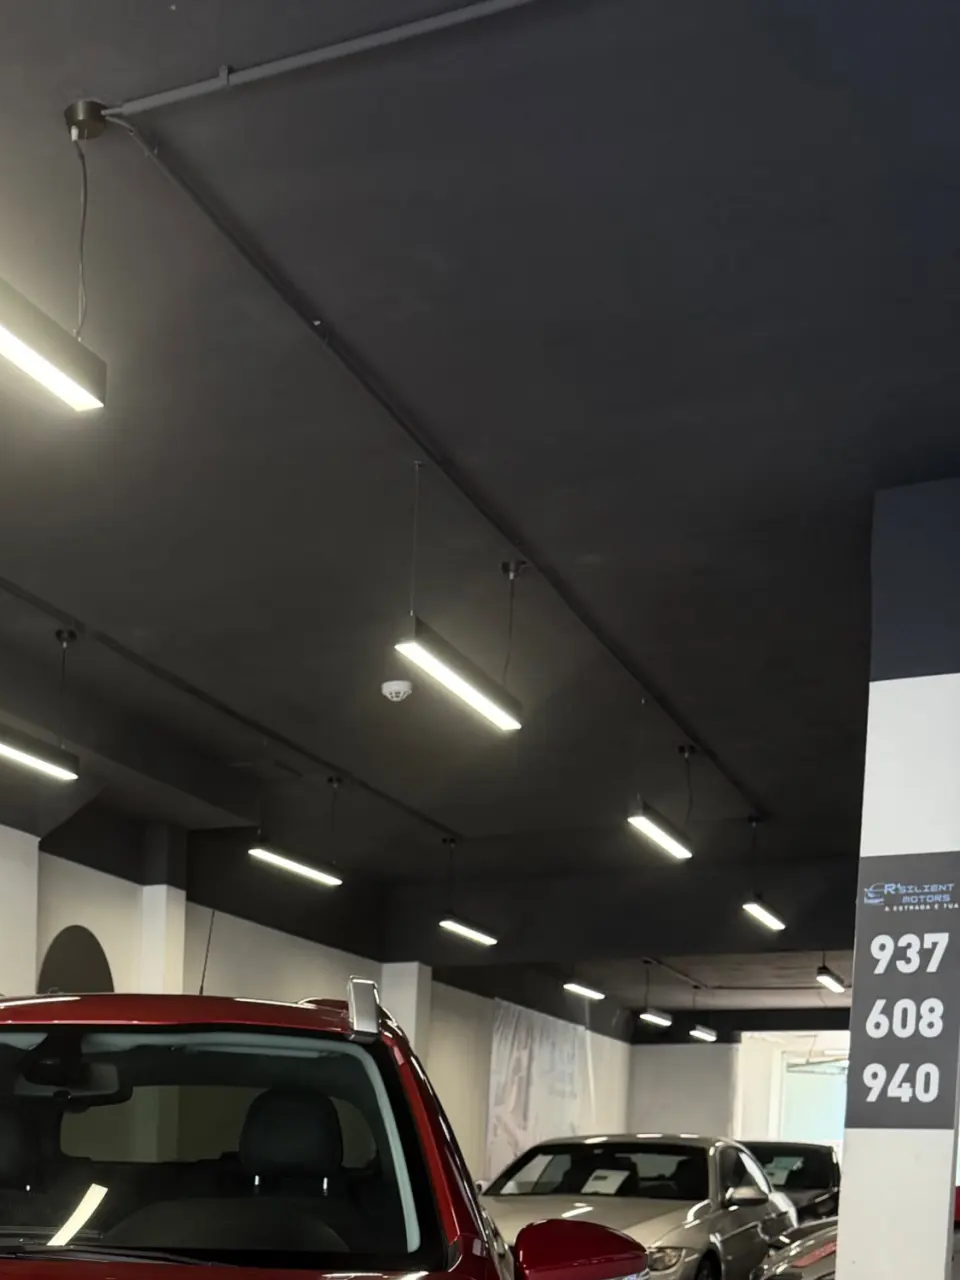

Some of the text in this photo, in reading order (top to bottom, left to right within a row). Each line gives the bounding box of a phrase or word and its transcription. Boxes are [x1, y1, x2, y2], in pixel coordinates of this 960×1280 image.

[902, 894, 951, 904] MOTORS
[870, 932, 949, 974] 937
[865, 998, 944, 1038] 608
[862, 1063, 940, 1103] 940
